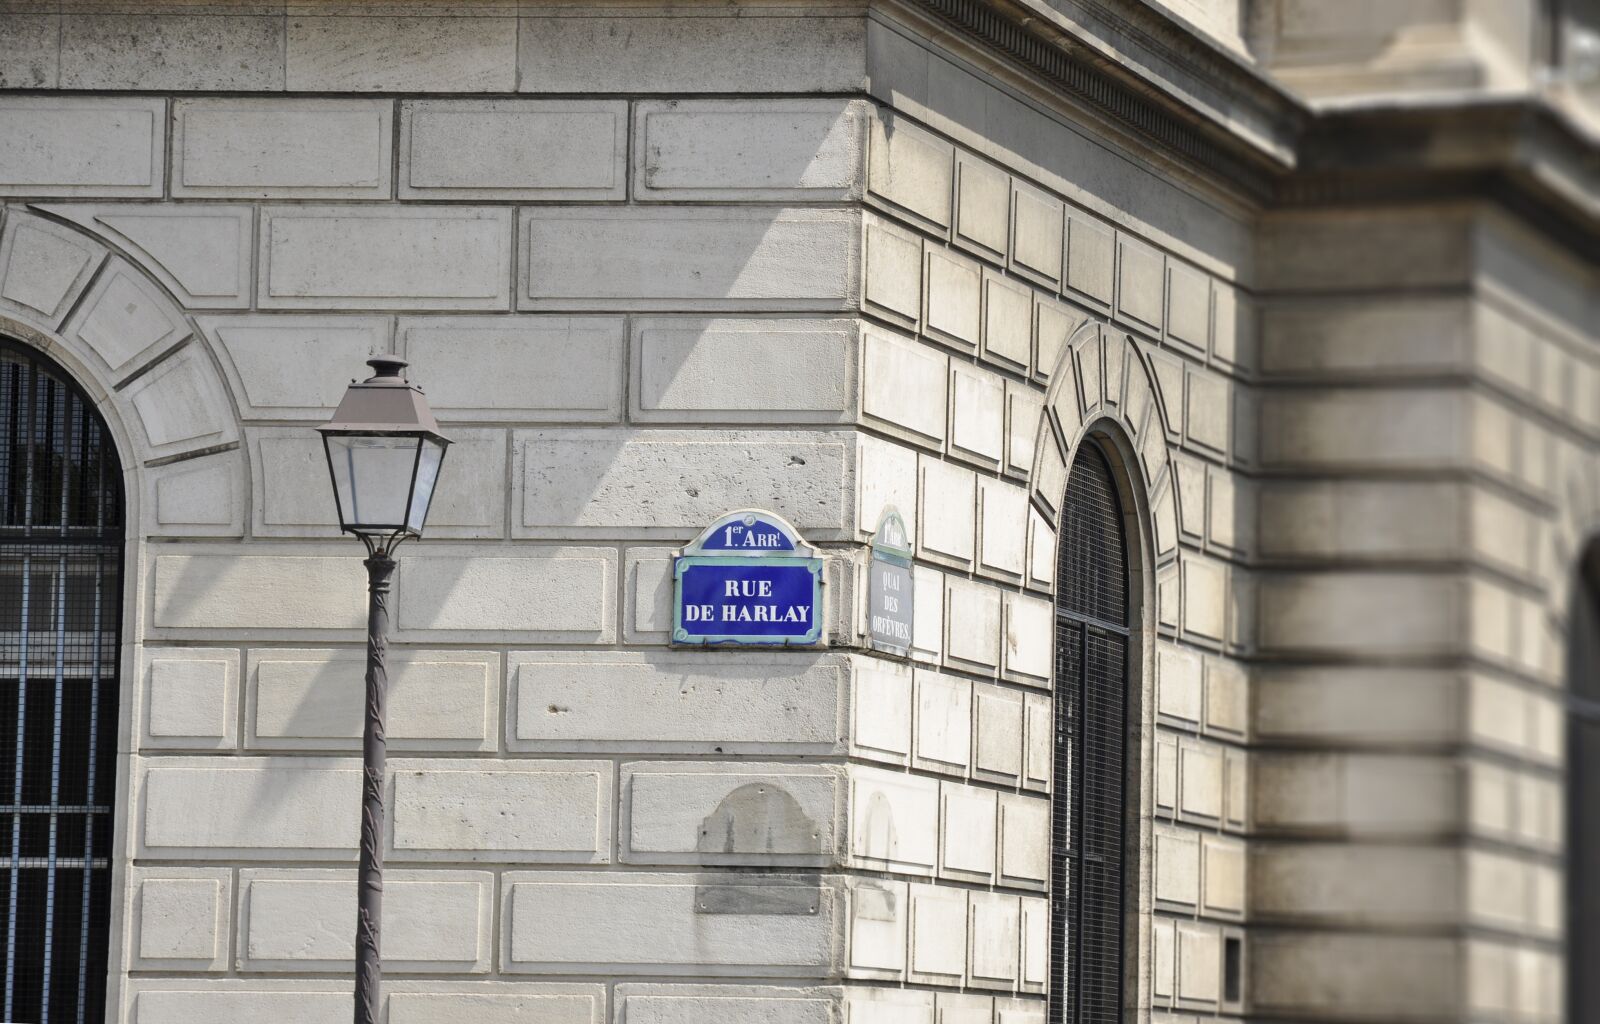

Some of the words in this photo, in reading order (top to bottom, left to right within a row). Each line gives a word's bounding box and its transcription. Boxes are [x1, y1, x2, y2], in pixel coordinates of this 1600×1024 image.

[725, 580, 772, 597] RUE
[883, 572, 900, 591] QUAI
[685, 604, 714, 622] DE
[721, 604, 811, 622] HARLAY
[884, 595, 899, 613] DES
